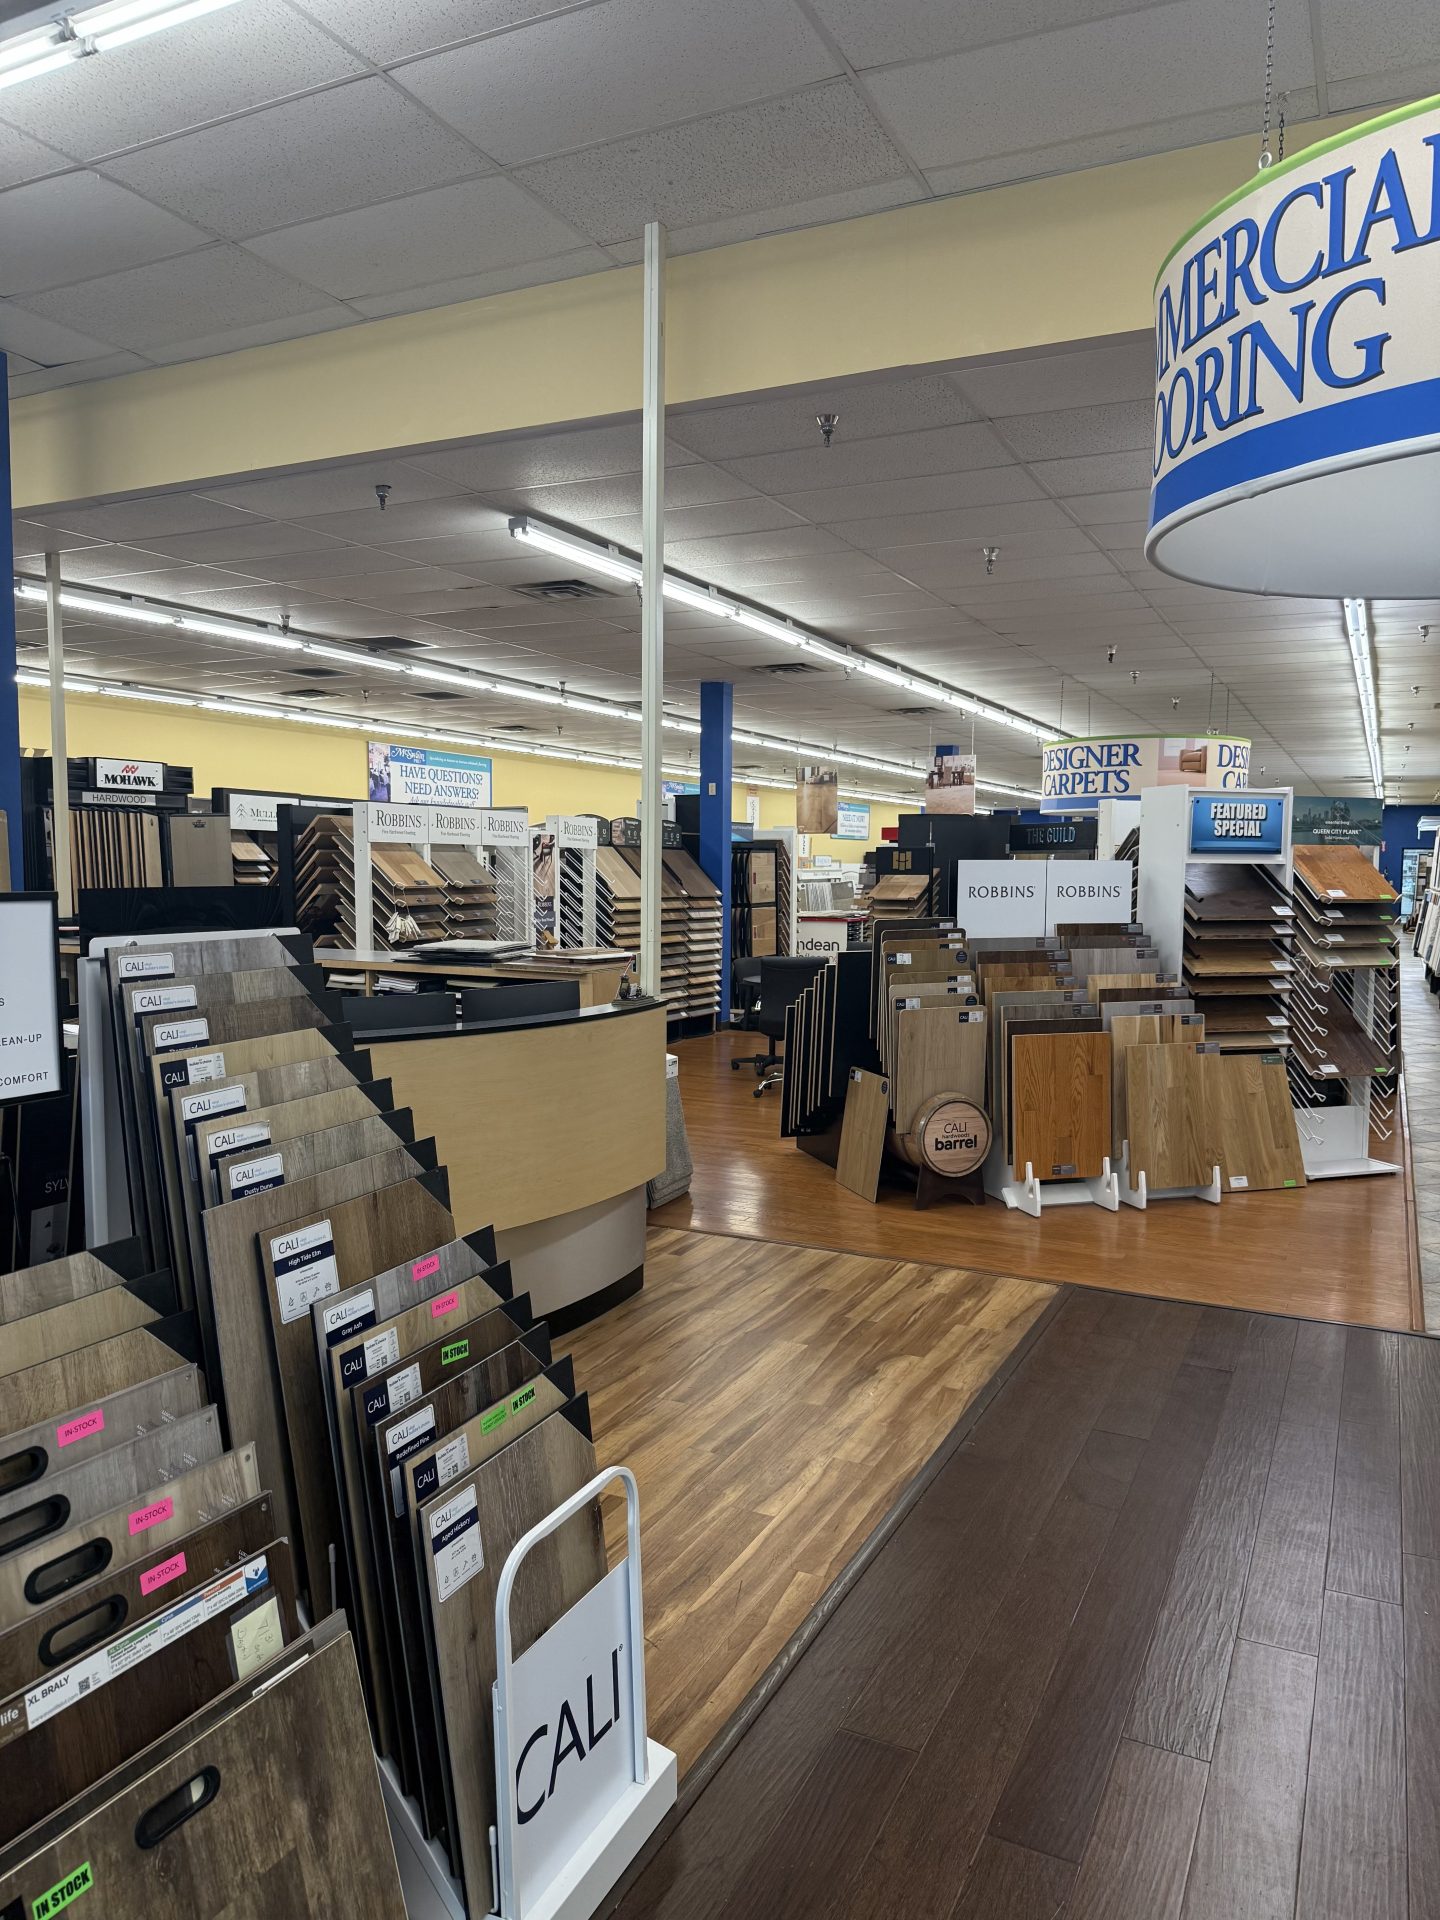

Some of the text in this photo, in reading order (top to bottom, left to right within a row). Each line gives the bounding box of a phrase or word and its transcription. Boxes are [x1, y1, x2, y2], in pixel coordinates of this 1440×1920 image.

[1043, 743, 1142, 773] DESIGNER
[104, 774, 157, 788] MOHAWK
[400, 765, 483, 786] HAVE QUESTIONS?
[1043, 770, 1130, 797] CARPETS
[92, 794, 147, 804] HARDWOOD
[405, 781, 479, 800] NEED ANSWERS?
[376, 810, 422, 828] ROBBINS
[1211, 802, 1267, 820] FEATURED
[436, 813, 475, 830] ROBBINS
[488, 817, 524, 832] ROBBINS
[564, 821, 593, 836] ROBBINS
[1214, 819, 1262, 838] SPECIAL
[1026, 826, 1076, 845] THE GUILD
[968, 885, 1035, 899] ROBBINS
[1056, 885, 1121, 898] ROBBINS
[125, 962, 144, 972] CALI
[140, 995, 161, 1008] CALI
[0, 1034, 42, 1047] EAN-UP
[160, 1029, 179, 1041] CALI
[164, 1071, 185, 1084] CALI
[189, 1099, 211, 1114] CALI
[943, 1122, 967, 1134] CALI
[214, 1132, 236, 1148] CALI
[934, 1134, 977, 1151] barrel
[235, 1168, 254, 1182] CALI
[245, 1183, 273, 1196] Dusty Dune
[278, 1237, 299, 1255] CALI
[288, 1257, 300, 1267] High
[300, 1253, 311, 1262] Tide
[329, 1307, 348, 1325] CALI
[341, 1321, 363, 1336] Gray Ash
[442, 1343, 468, 1361] IN STOCK
[343, 1357, 363, 1376] CALI
[367, 1394, 386, 1413] CALI
[512, 1387, 536, 1411] IN STOCK
[391, 1426, 409, 1445] CALI
[396, 1435, 430, 1460] Redefined Pine
[417, 1468, 435, 1489] CALI
[435, 1508, 452, 1528] CALI
[441, 1517, 471, 1543] Aged Hickory
[147, 1561, 180, 1584] IN-STOCK
[27, 1675, 70, 1708] XL BRALY
[35, 1868, 91, 1919] IN STOCK
